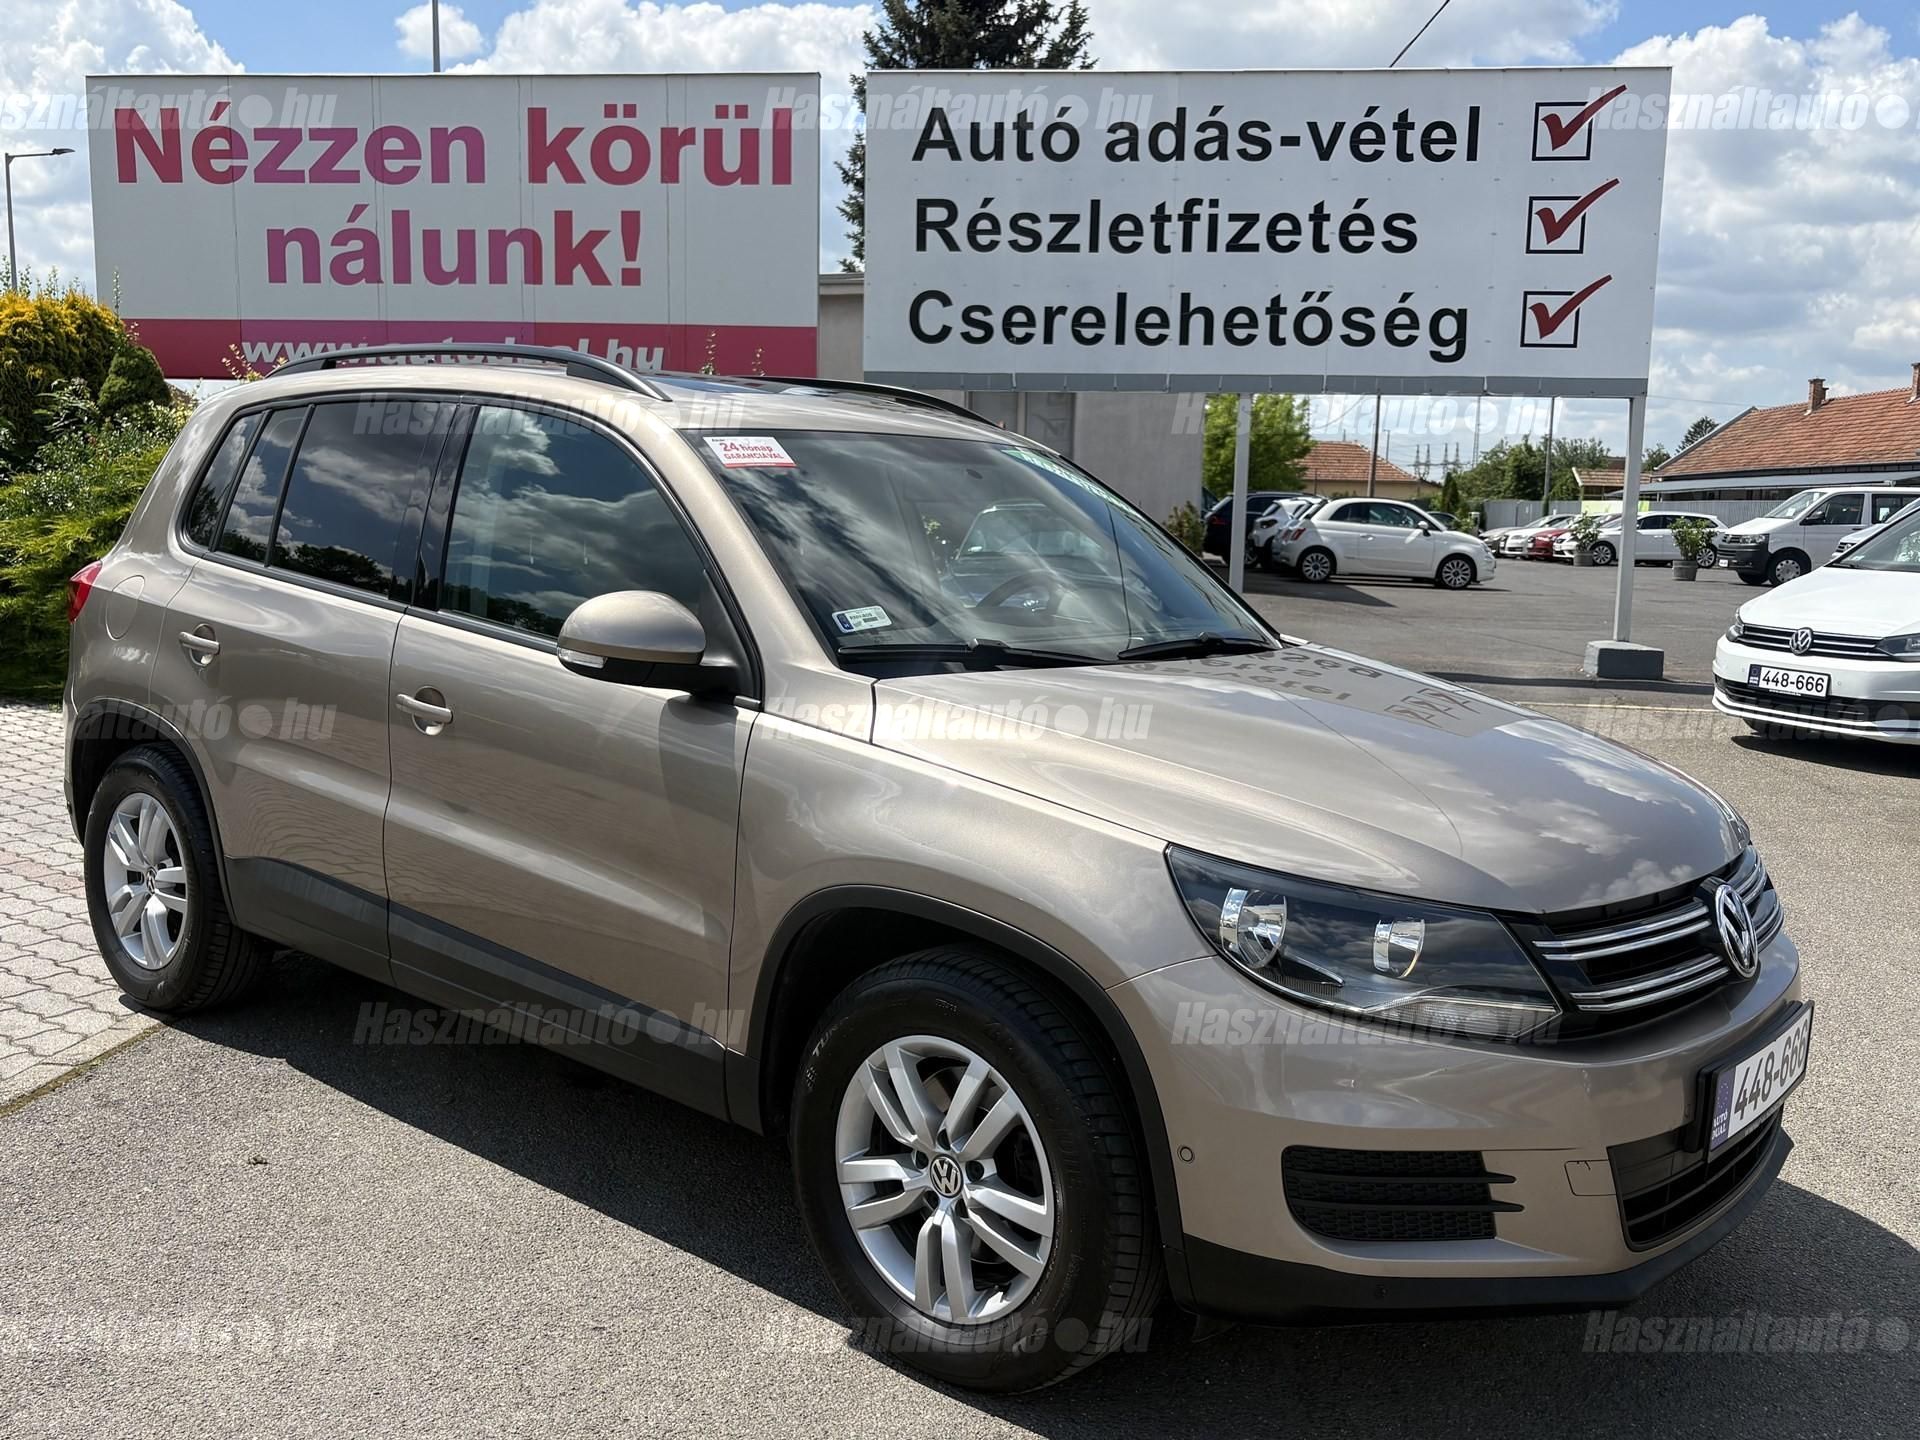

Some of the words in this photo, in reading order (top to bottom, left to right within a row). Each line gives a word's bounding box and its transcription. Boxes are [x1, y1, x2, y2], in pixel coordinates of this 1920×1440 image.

[114, 102, 485, 184] Nézzen
[527, 104, 792, 186] körül
[912, 105, 1080, 163] Autó
[1105, 105, 1481, 163] adás-vétel
[267, 205, 641, 286] nálunk!
[915, 197, 1418, 254] Részletfizetés
[909, 289, 1468, 363] Cserelehetőség
[719, 442, 739, 452] 24
[1762, 670, 1825, 693] 448-666
[1733, 1018, 1808, 1121] 448-666
